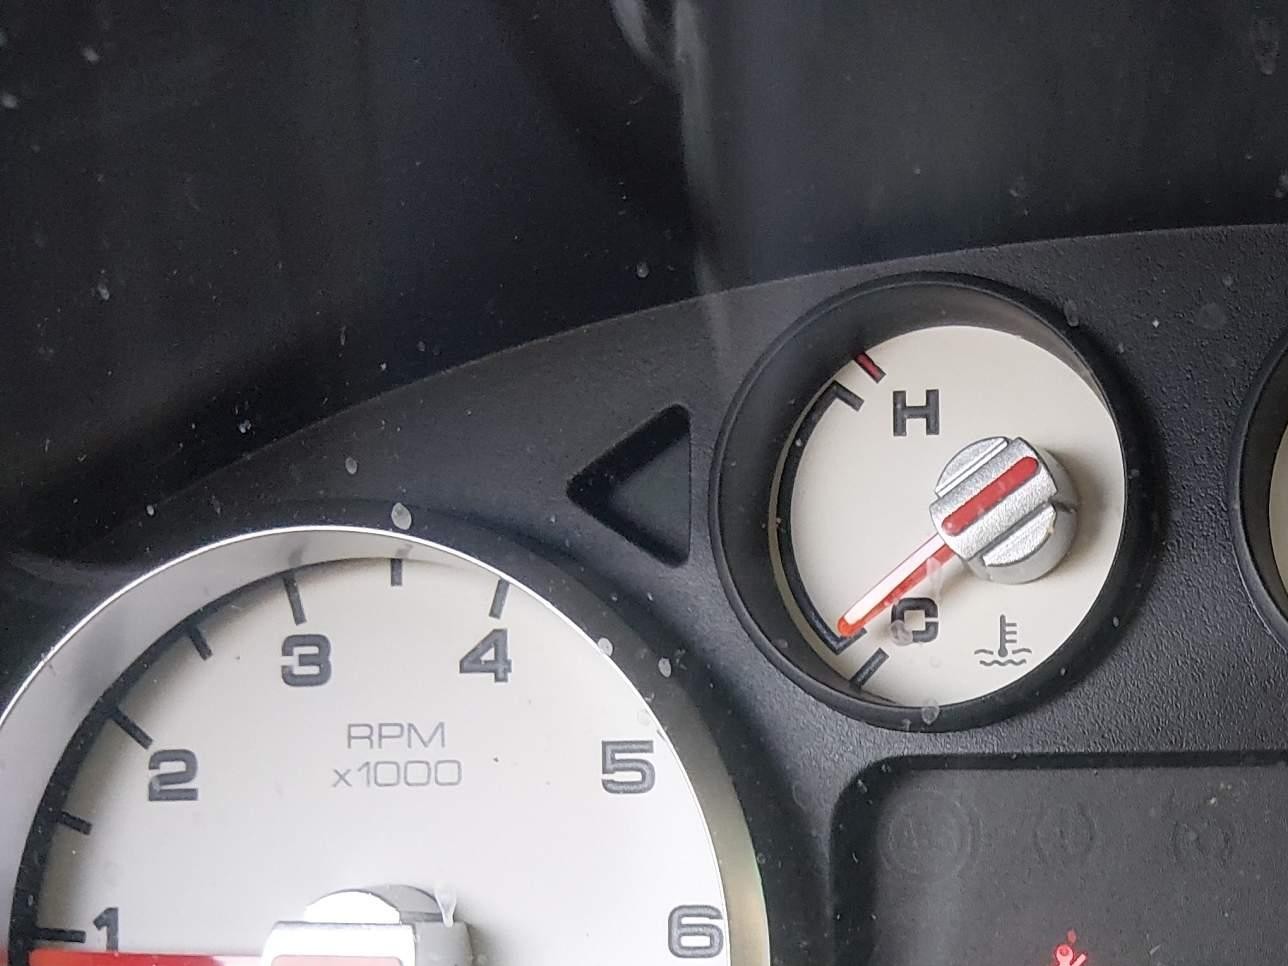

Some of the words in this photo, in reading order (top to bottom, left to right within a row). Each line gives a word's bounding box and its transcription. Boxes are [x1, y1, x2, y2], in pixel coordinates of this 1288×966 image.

[892, 389, 939, 437] H
[890, 597, 939, 643] C
[281, 634, 332, 687] 3
[459, 629, 512, 683] 4
[346, 722, 447, 749] RPM
[148, 749, 199, 802] 2
[331, 759, 463, 788] x1000
[601, 740, 656, 795] 5
[93, 908, 119, 952] 1
[668, 905, 724, 960] 6
